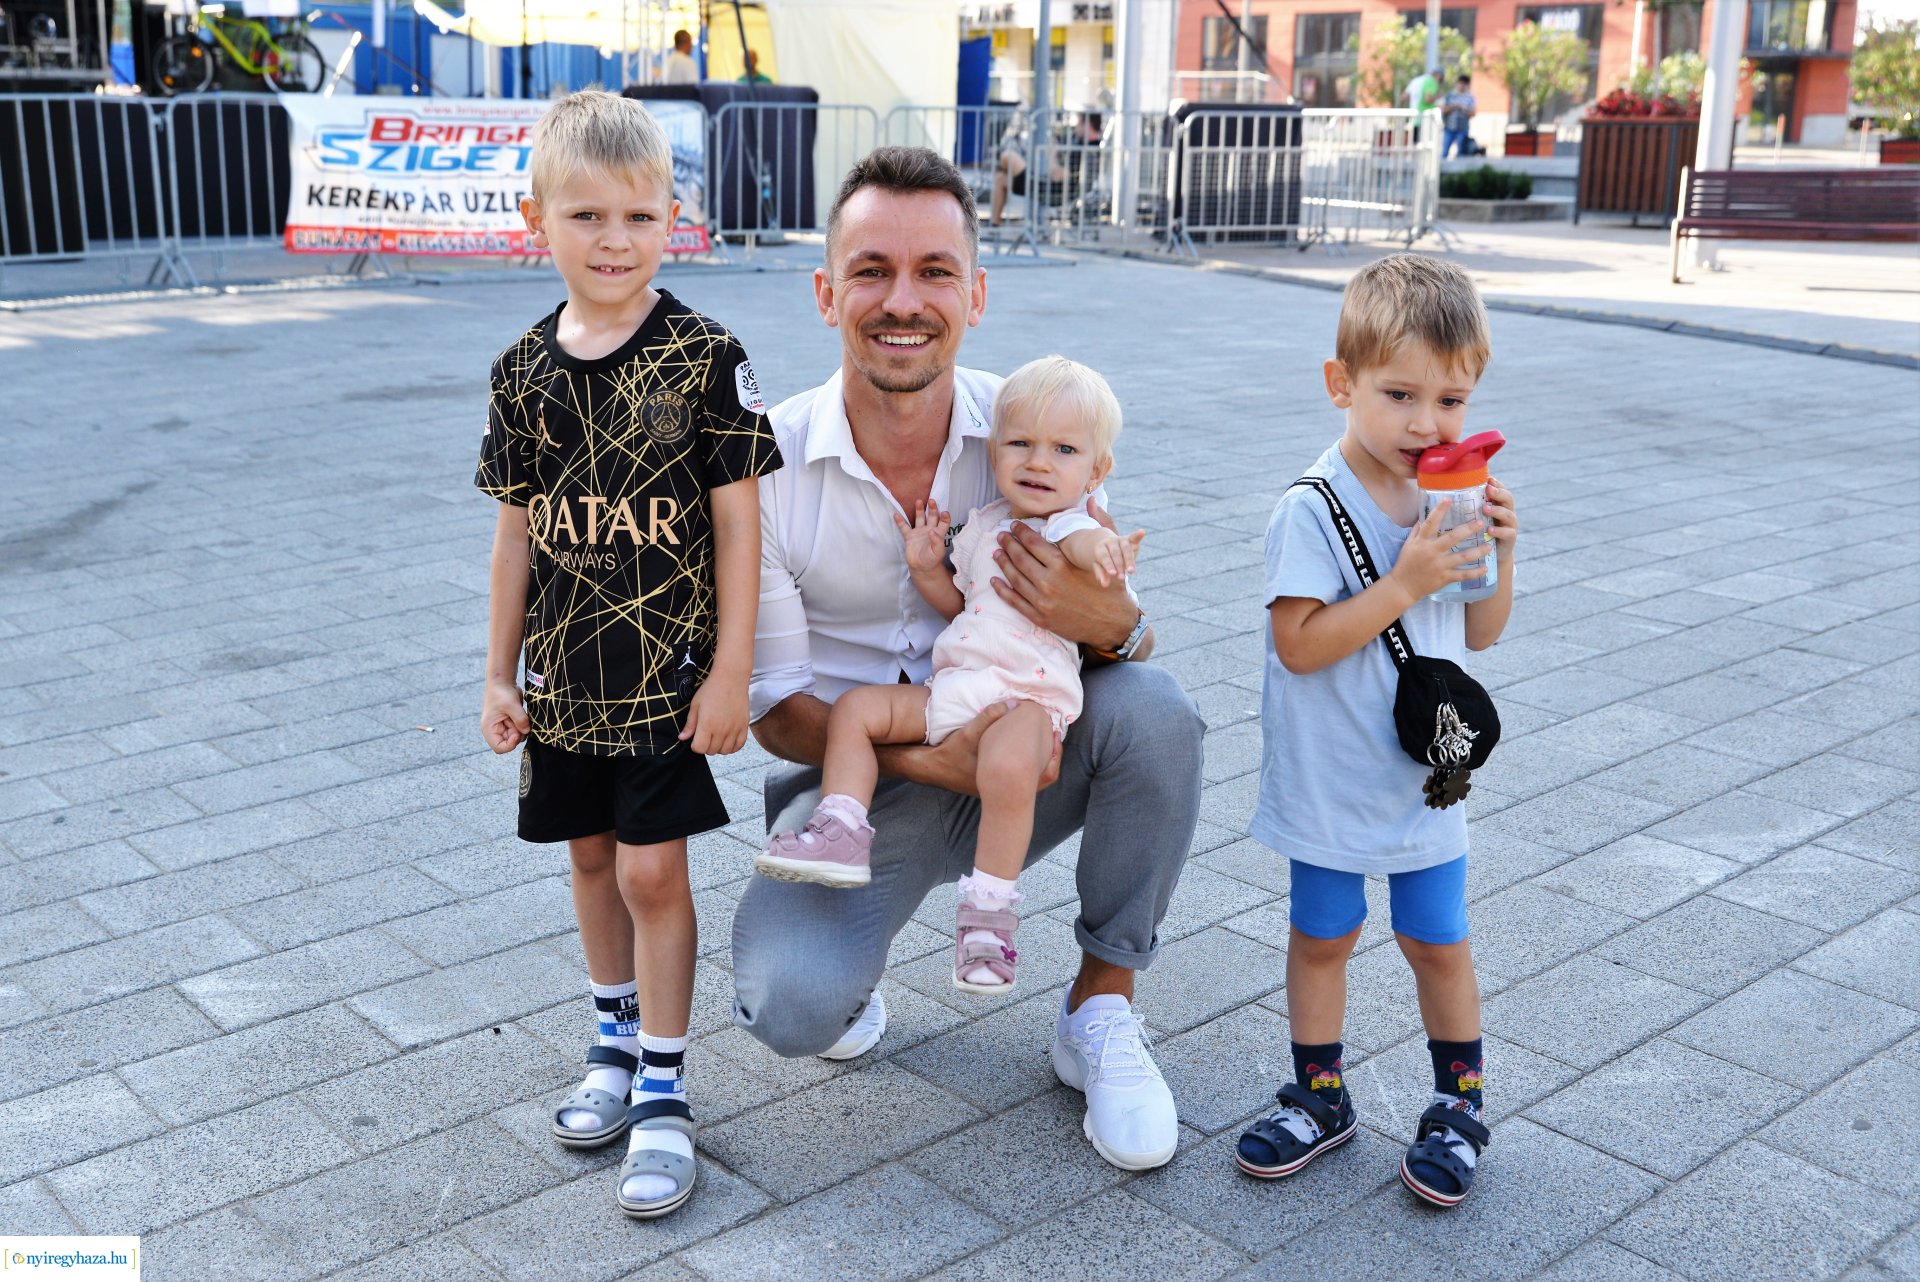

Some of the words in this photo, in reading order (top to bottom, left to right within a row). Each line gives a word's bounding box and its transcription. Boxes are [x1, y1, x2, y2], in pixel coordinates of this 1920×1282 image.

[320, 133, 533, 171] SZIGET
[307, 183, 455, 213] KERÉKPÁR
[463, 186, 526, 213] ÜZLE
[294, 227, 382, 250] RUHÁZAT
[649, 393, 683, 407] PARIS
[528, 494, 681, 555] QATAR
[1339, 517, 1365, 567] LITTLE
[553, 550, 616, 570] AIRWAYS
